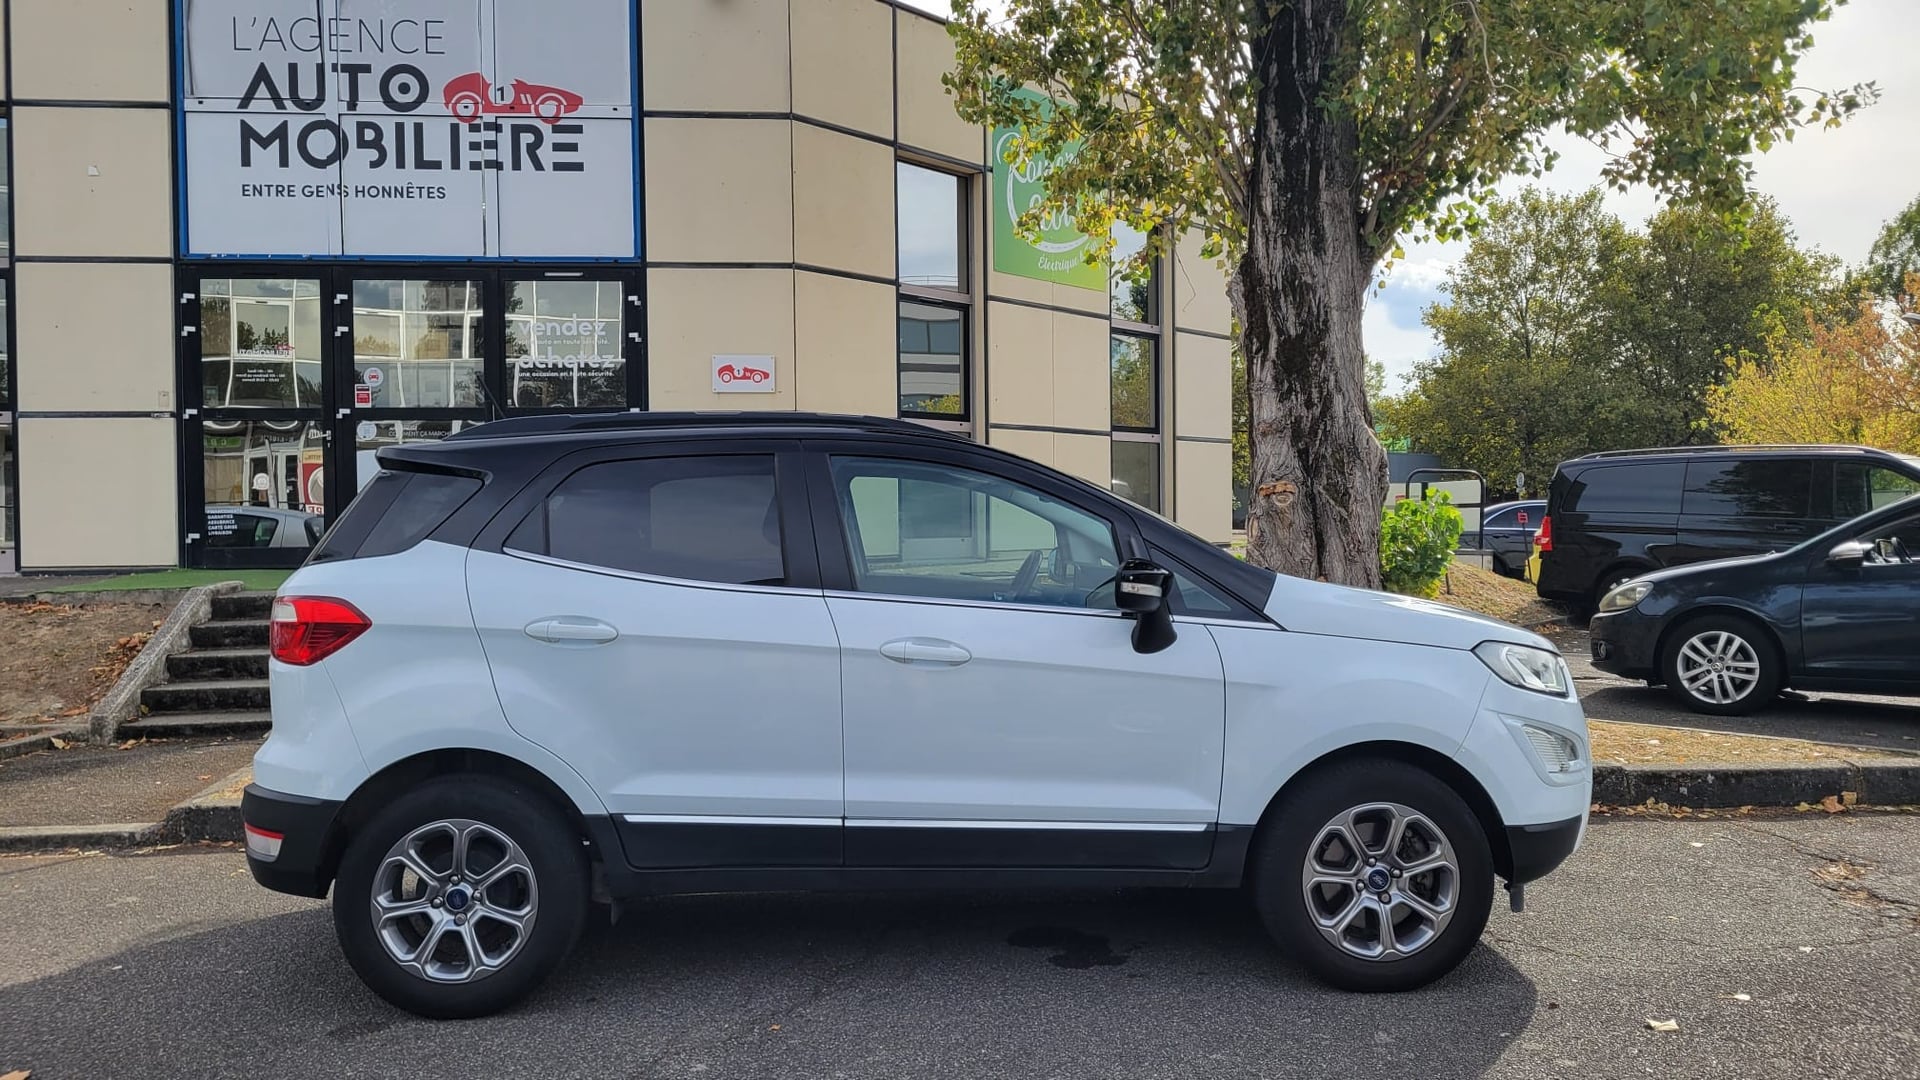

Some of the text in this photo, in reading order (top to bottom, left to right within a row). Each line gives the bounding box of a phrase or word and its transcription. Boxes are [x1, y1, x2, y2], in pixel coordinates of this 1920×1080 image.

[237, 62, 430, 112] AUTO
[241, 182, 446, 200] ENTRE GENS HONNÊTES
[519, 313, 606, 336] vendez
[519, 346, 615, 368] achetez
